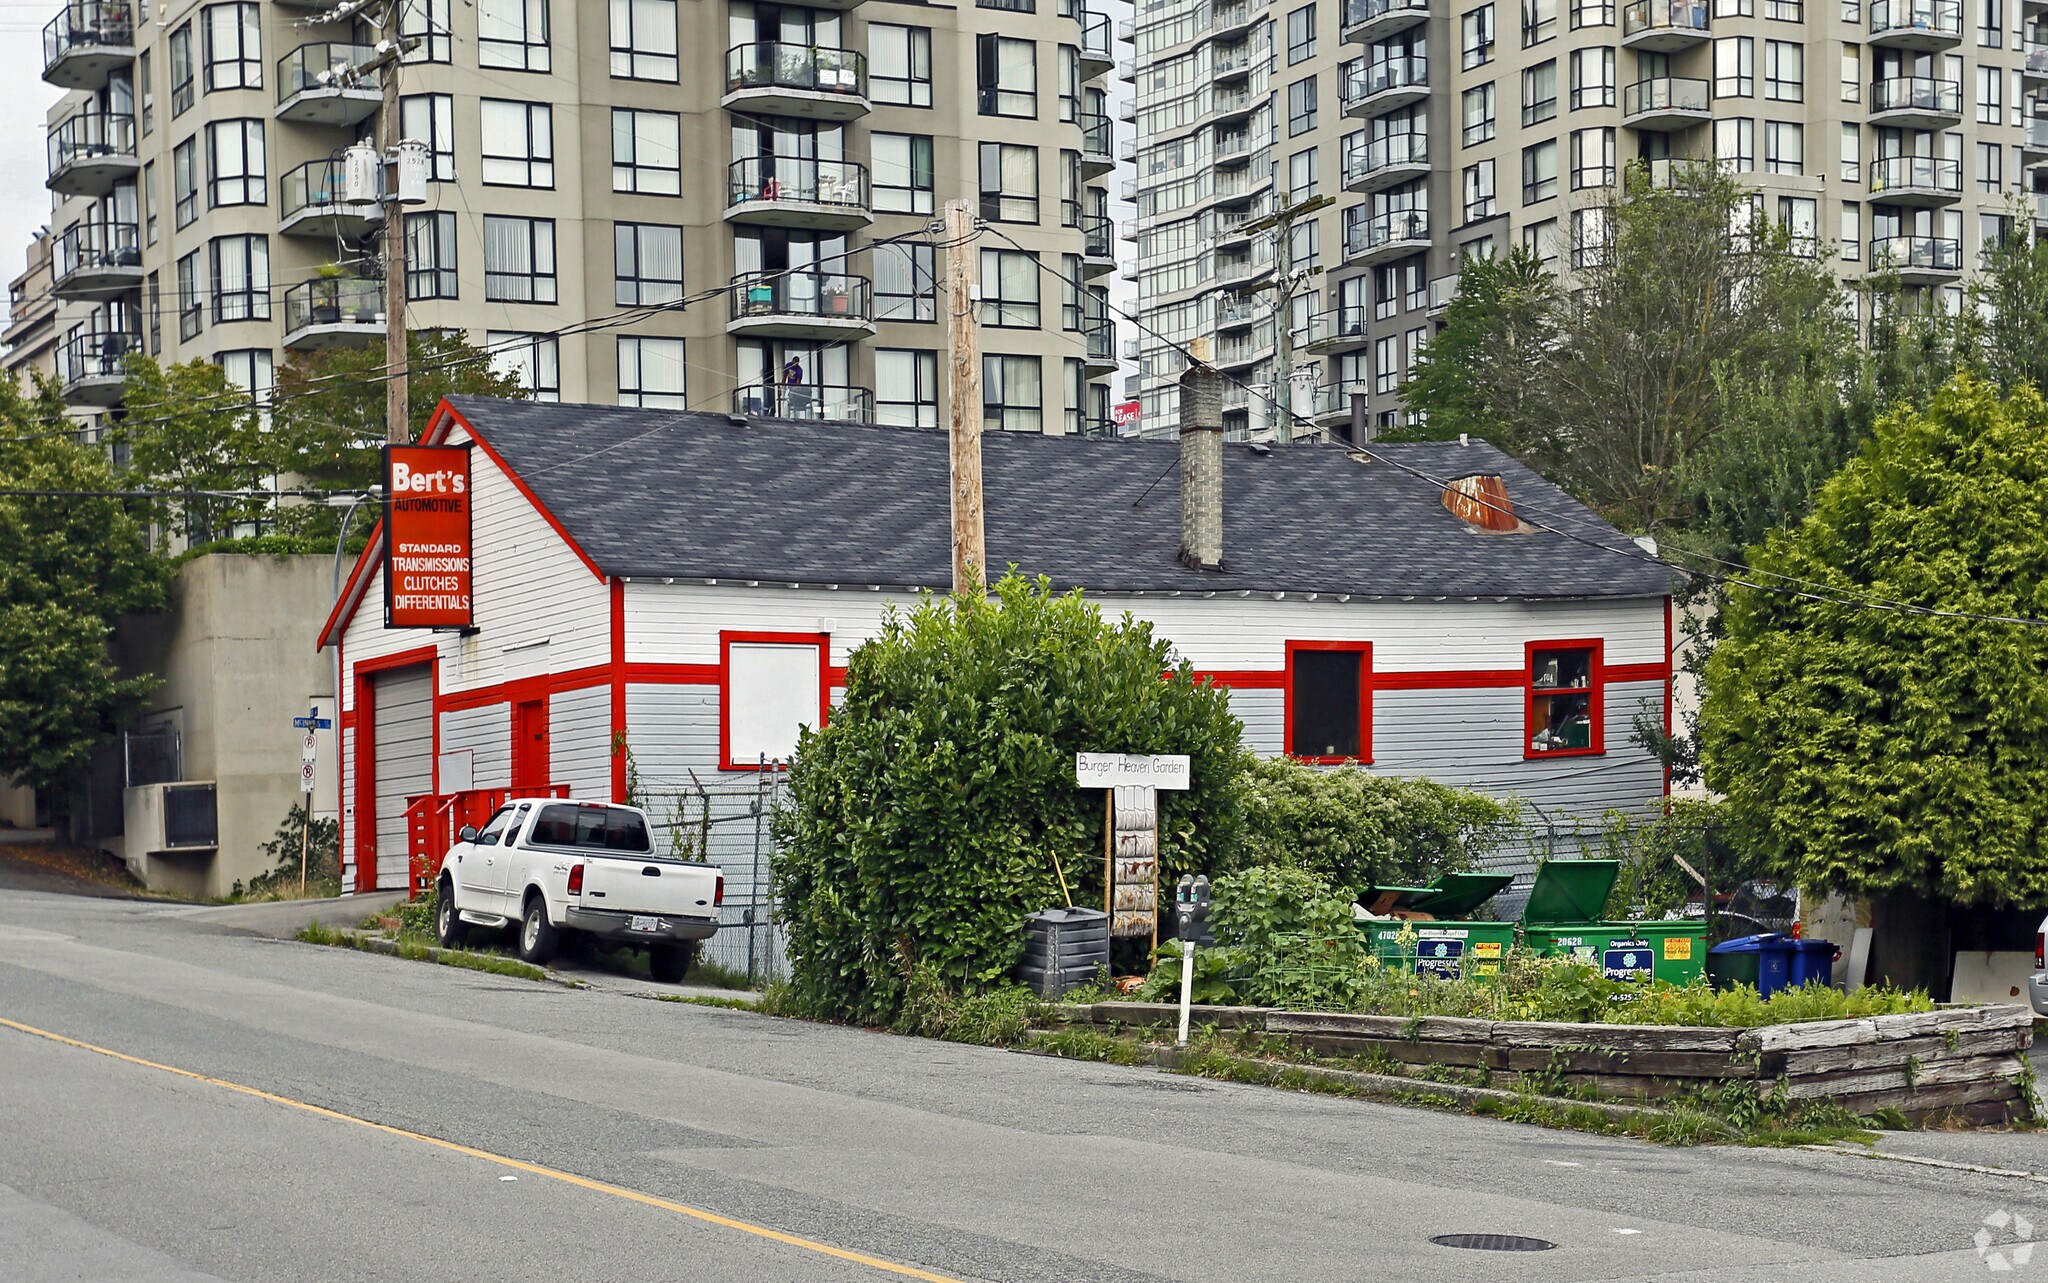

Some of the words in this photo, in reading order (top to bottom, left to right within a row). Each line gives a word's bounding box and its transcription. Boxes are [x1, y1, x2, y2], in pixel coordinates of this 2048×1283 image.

[1115, 412, 1134, 423] LEASE
[392, 462, 465, 493] Bert's
[394, 497, 463, 513] AUTOMOTIVE
[399, 543, 461, 554] STANDARD
[392, 557, 469, 572] TRANSMISSIONS
[404, 576, 458, 591] CLUTCHES
[395, 595, 469, 610] DIFFERENTIALS
[1079, 755, 1114, 777] Burger
[1118, 757, 1149, 774] Heaven
[1152, 758, 1184, 774] Garden
[1557, 937, 1582, 946] 20628
[1610, 940, 1635, 948] Organics
